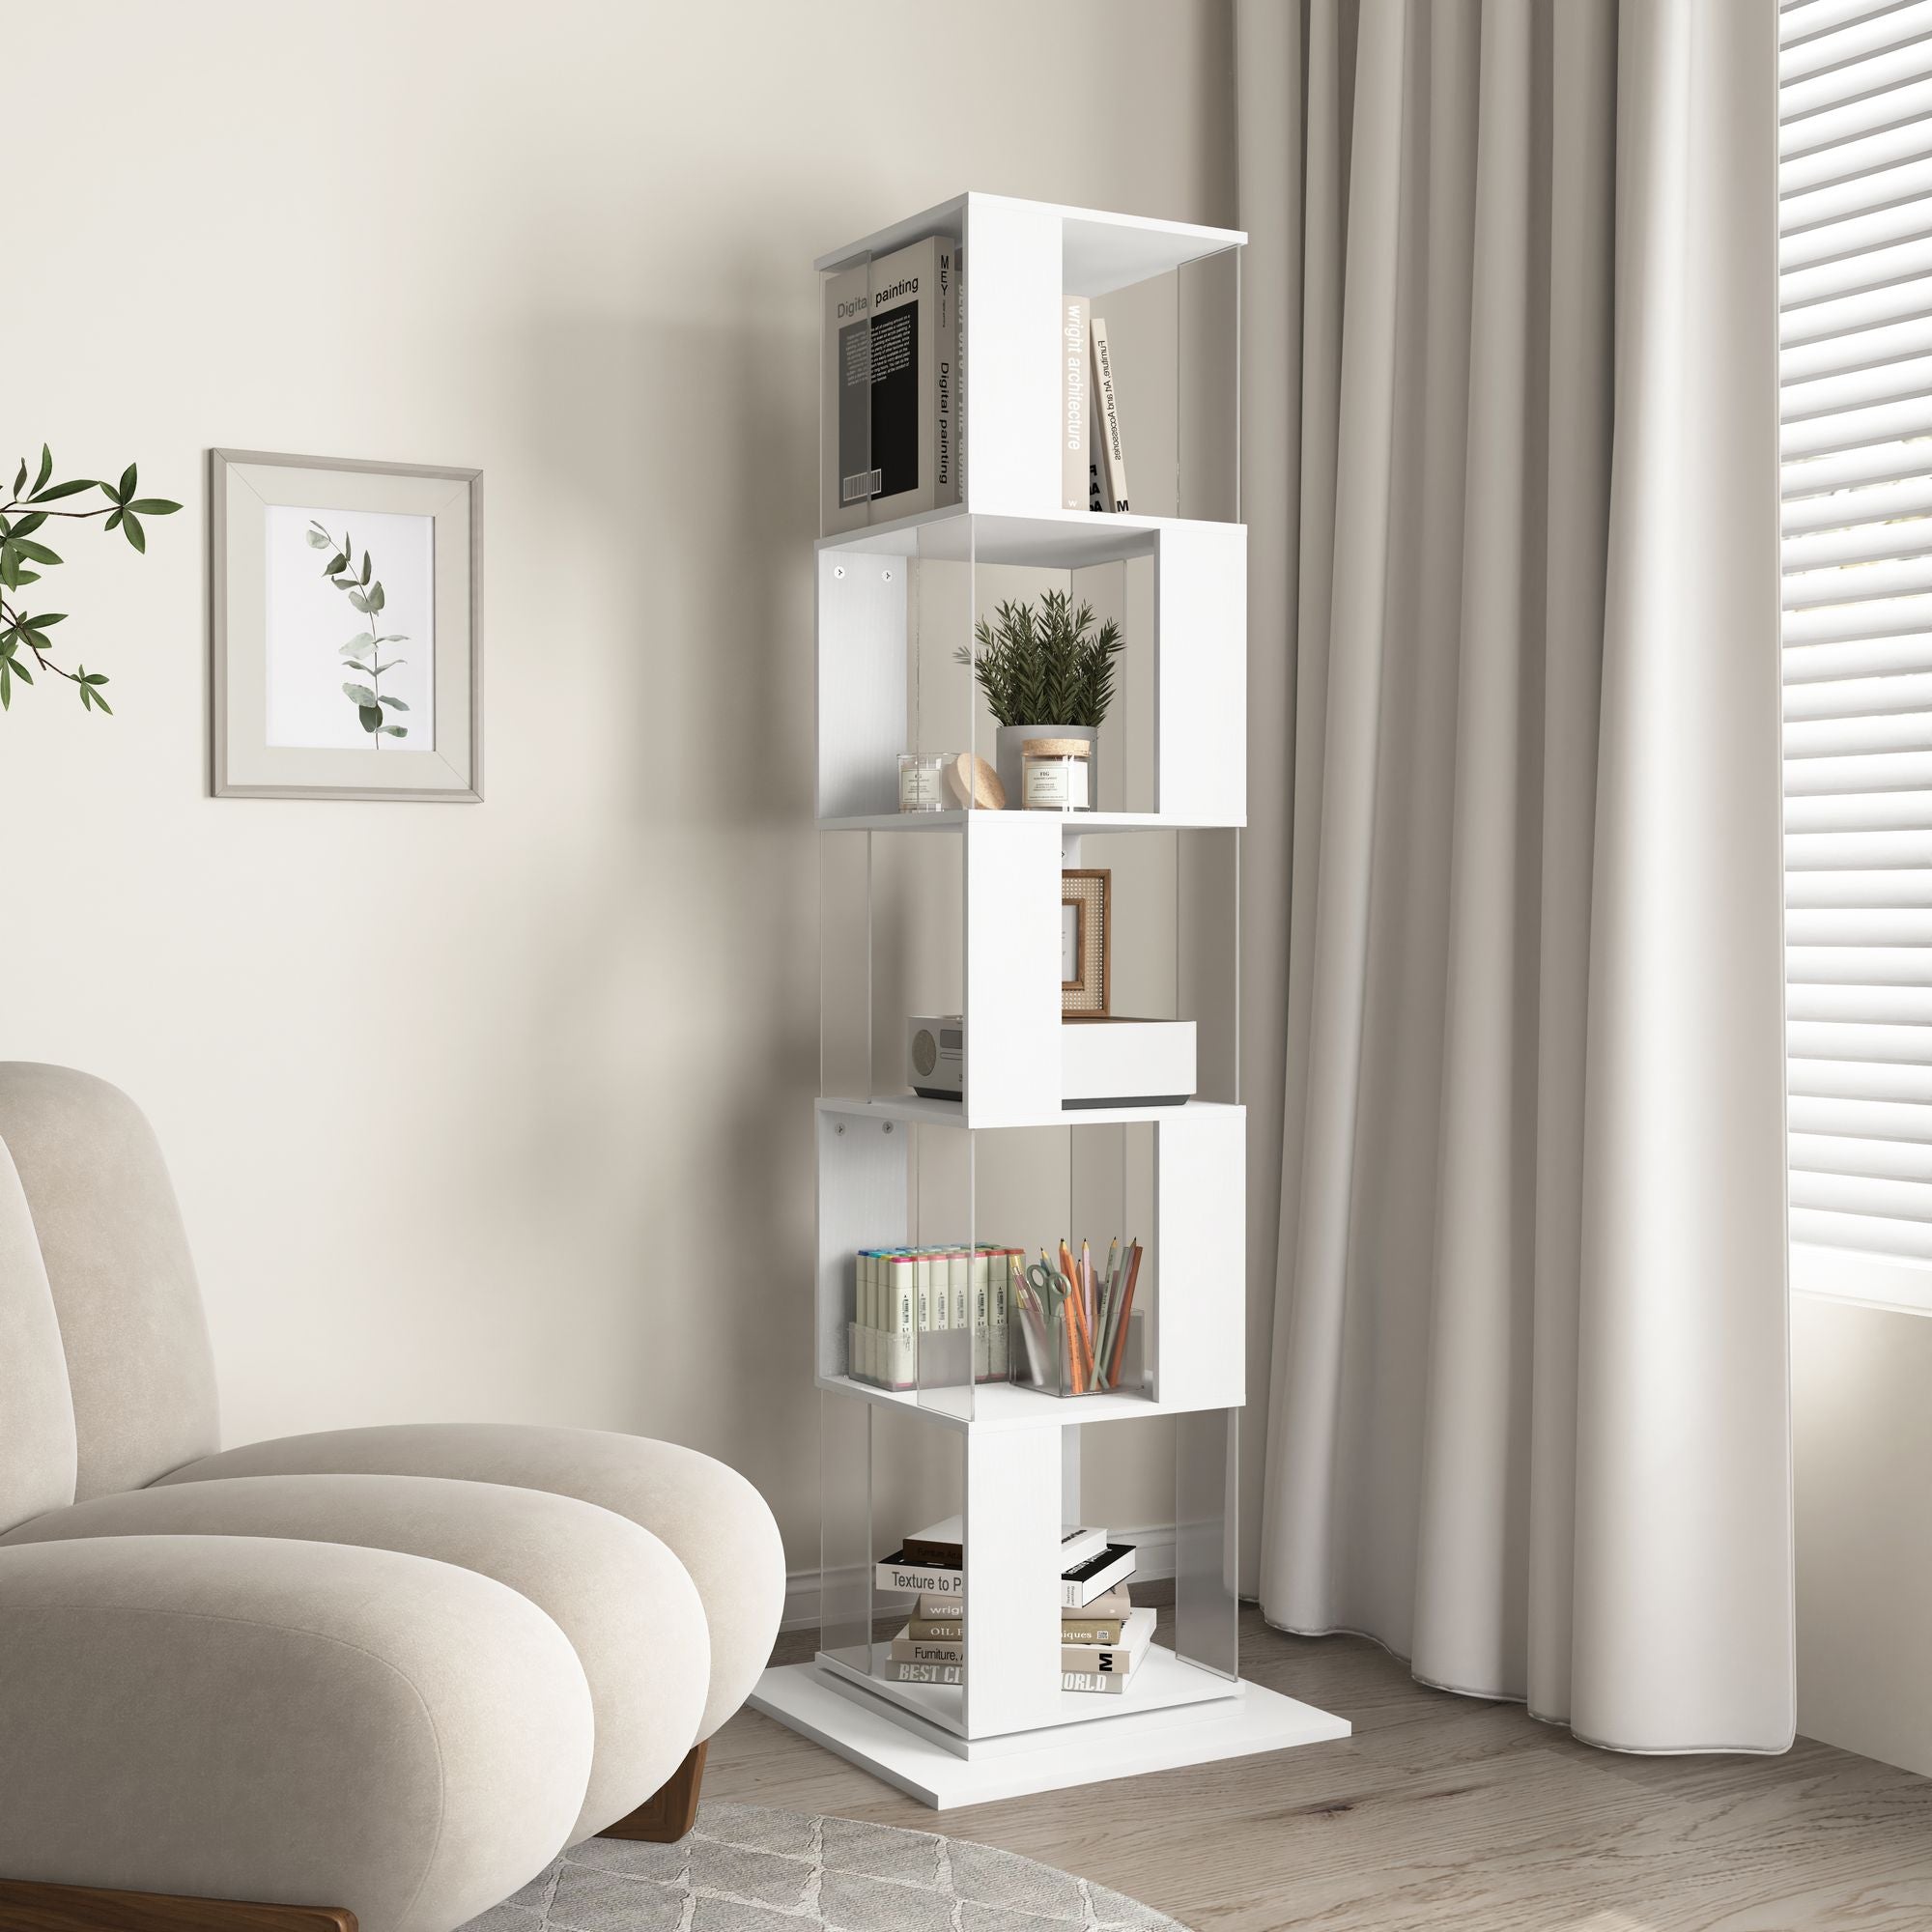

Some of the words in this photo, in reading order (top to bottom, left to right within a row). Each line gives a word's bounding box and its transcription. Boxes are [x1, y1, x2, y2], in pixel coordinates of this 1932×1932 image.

[940, 254, 950, 297] MEY
[874, 276, 919, 307] painting
[1065, 305, 1084, 352] wright
[938, 362, 950, 413] Digital
[1067, 356, 1084, 450] architecture
[938, 419, 950, 485] painting
[891, 1571, 935, 1590] Texture
[938, 1576, 950, 1591] to
[930, 1627, 953, 1636] OIL
[1062, 1630, 1093, 1640] iques
[915, 1646, 958, 1662] Furniture,
[1098, 1653, 1113, 1672] M
[898, 1662, 940, 1681] BEST
[1062, 1672, 1107, 1691] ORLD
